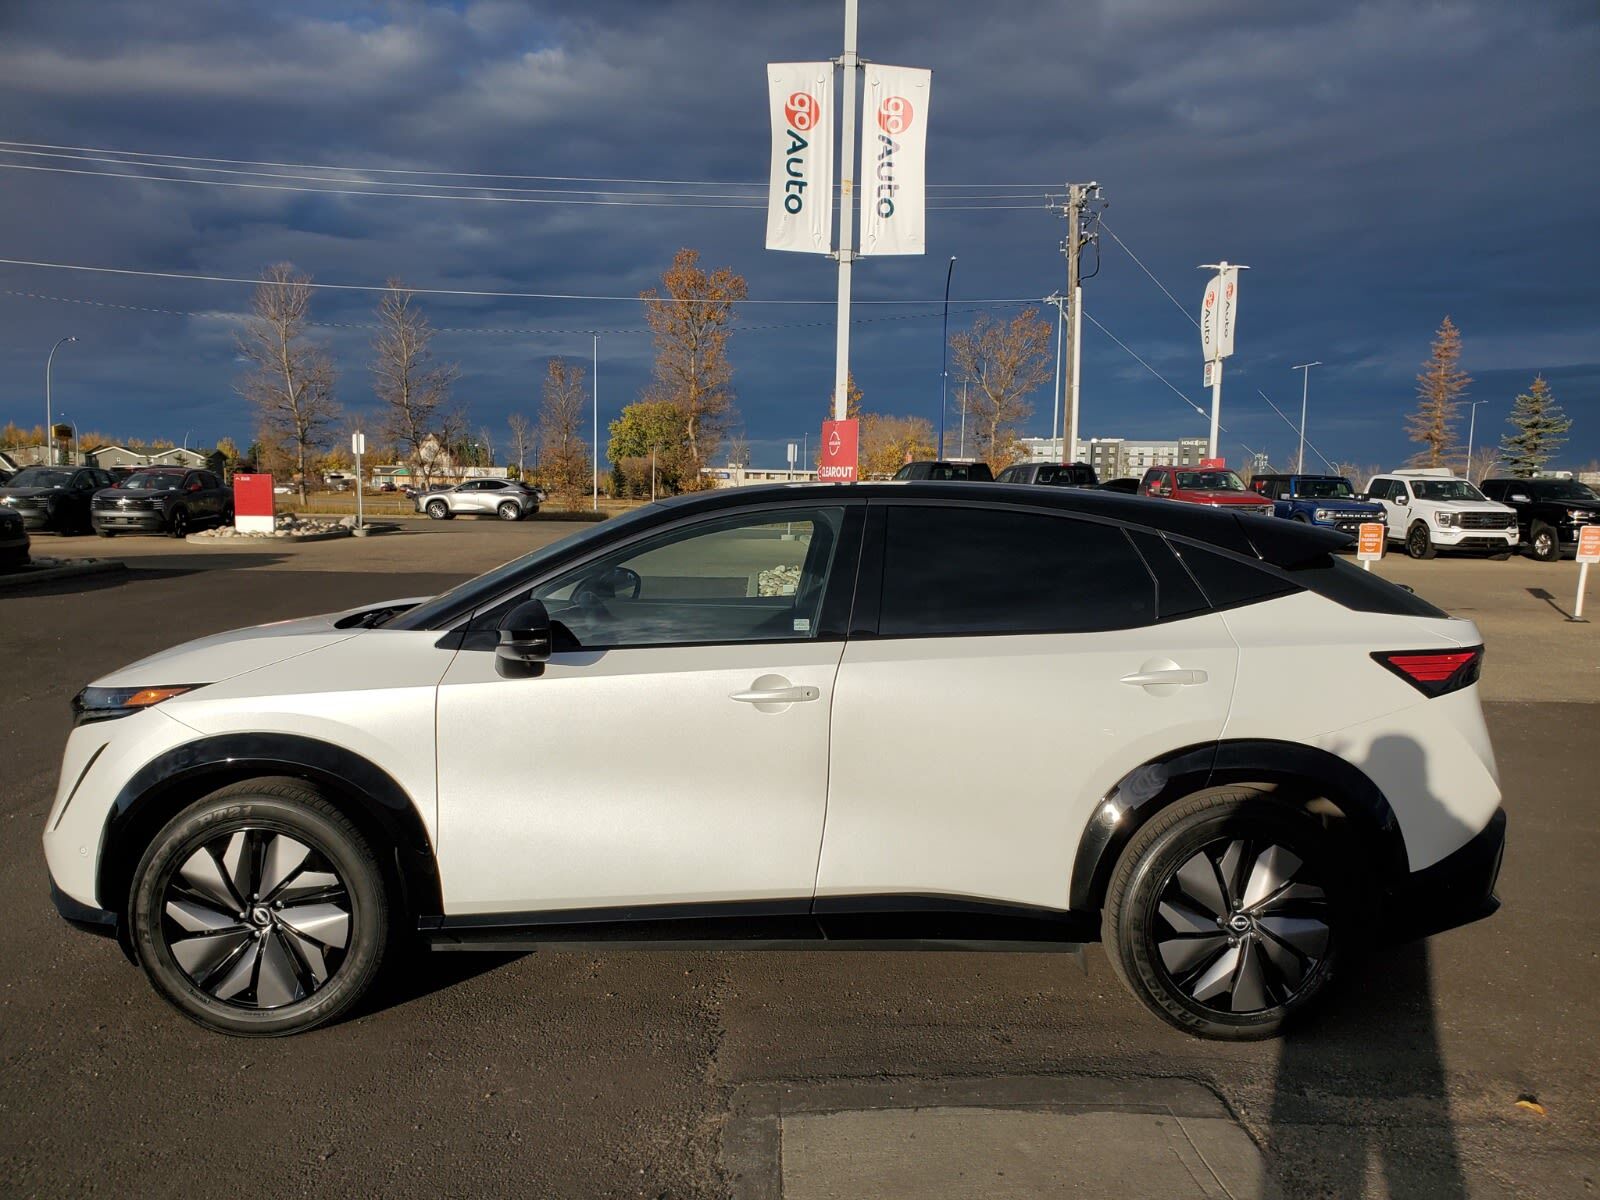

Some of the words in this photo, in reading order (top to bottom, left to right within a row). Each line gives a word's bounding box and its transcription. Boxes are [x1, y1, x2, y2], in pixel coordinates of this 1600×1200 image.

[786, 93, 811, 131] go
[784, 129, 809, 215] Auto
[877, 134, 901, 219] Auto
[821, 466, 853, 478] CLEAROUT
